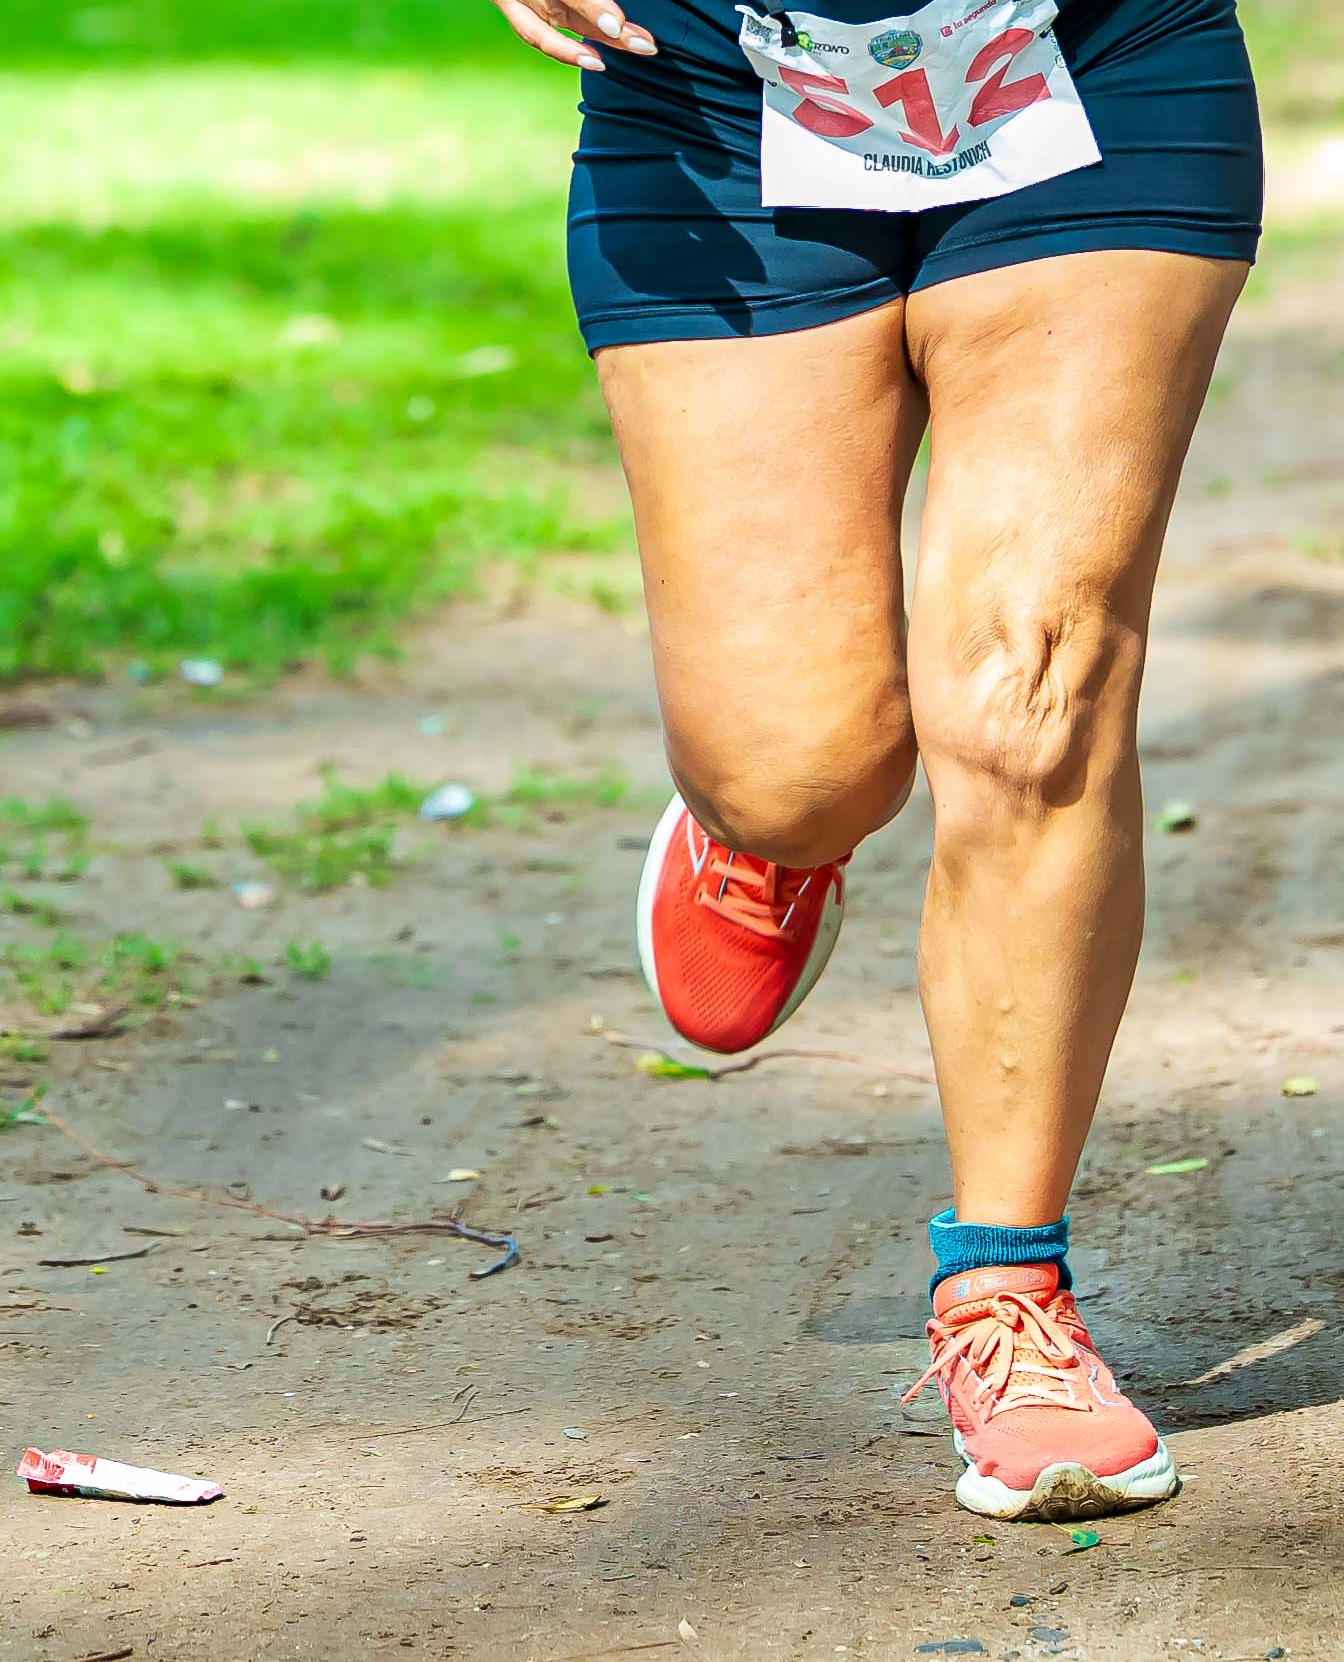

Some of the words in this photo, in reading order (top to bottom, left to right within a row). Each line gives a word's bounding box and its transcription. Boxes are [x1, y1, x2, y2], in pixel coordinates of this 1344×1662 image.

[964, 0, 997, 24] segunda
[778, 27, 1052, 156] 512
[864, 153, 923, 175] CLAUDIA
